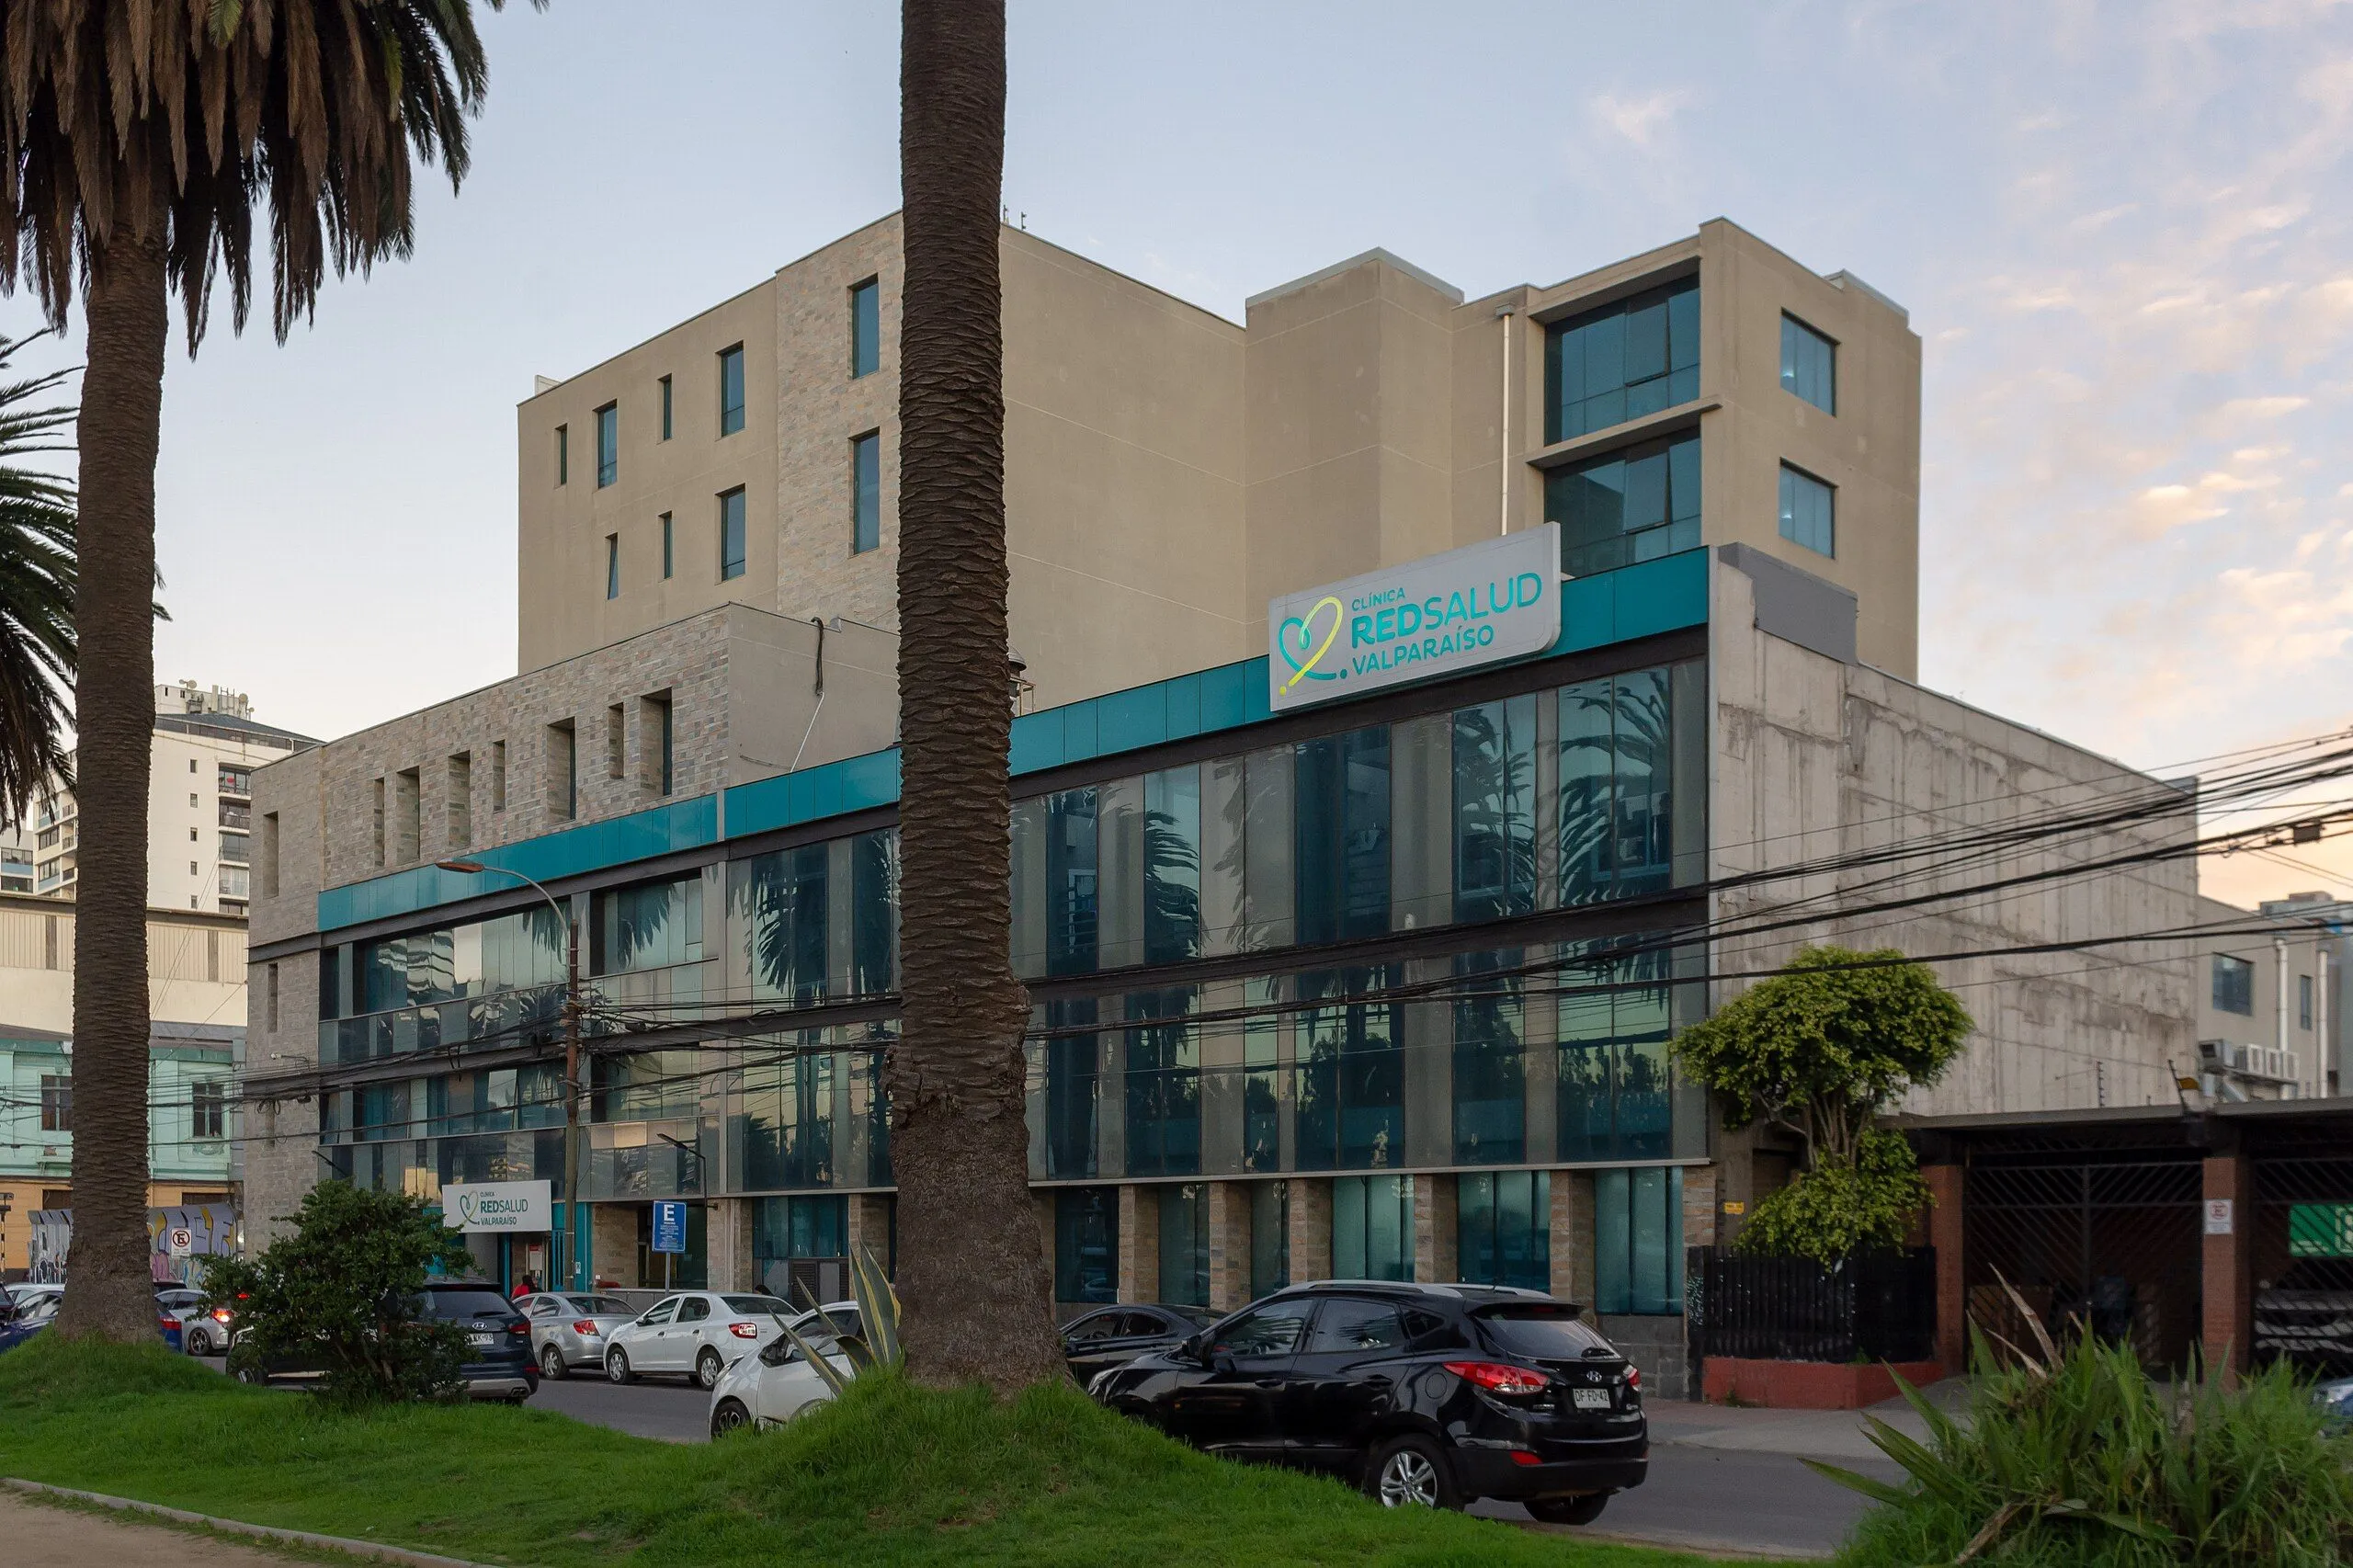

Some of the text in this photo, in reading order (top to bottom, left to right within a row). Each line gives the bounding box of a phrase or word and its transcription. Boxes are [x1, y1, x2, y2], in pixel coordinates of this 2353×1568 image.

[1351, 587, 1405, 612] CLÍNICA
[1351, 572, 1542, 649] REDSALUD
[1352, 624, 1495, 676] VALPARAÍSO
[480, 1199, 529, 1213] REDSALUD
[664, 1204, 675, 1221] E
[481, 1215, 517, 1225] VALPARAÍSO
